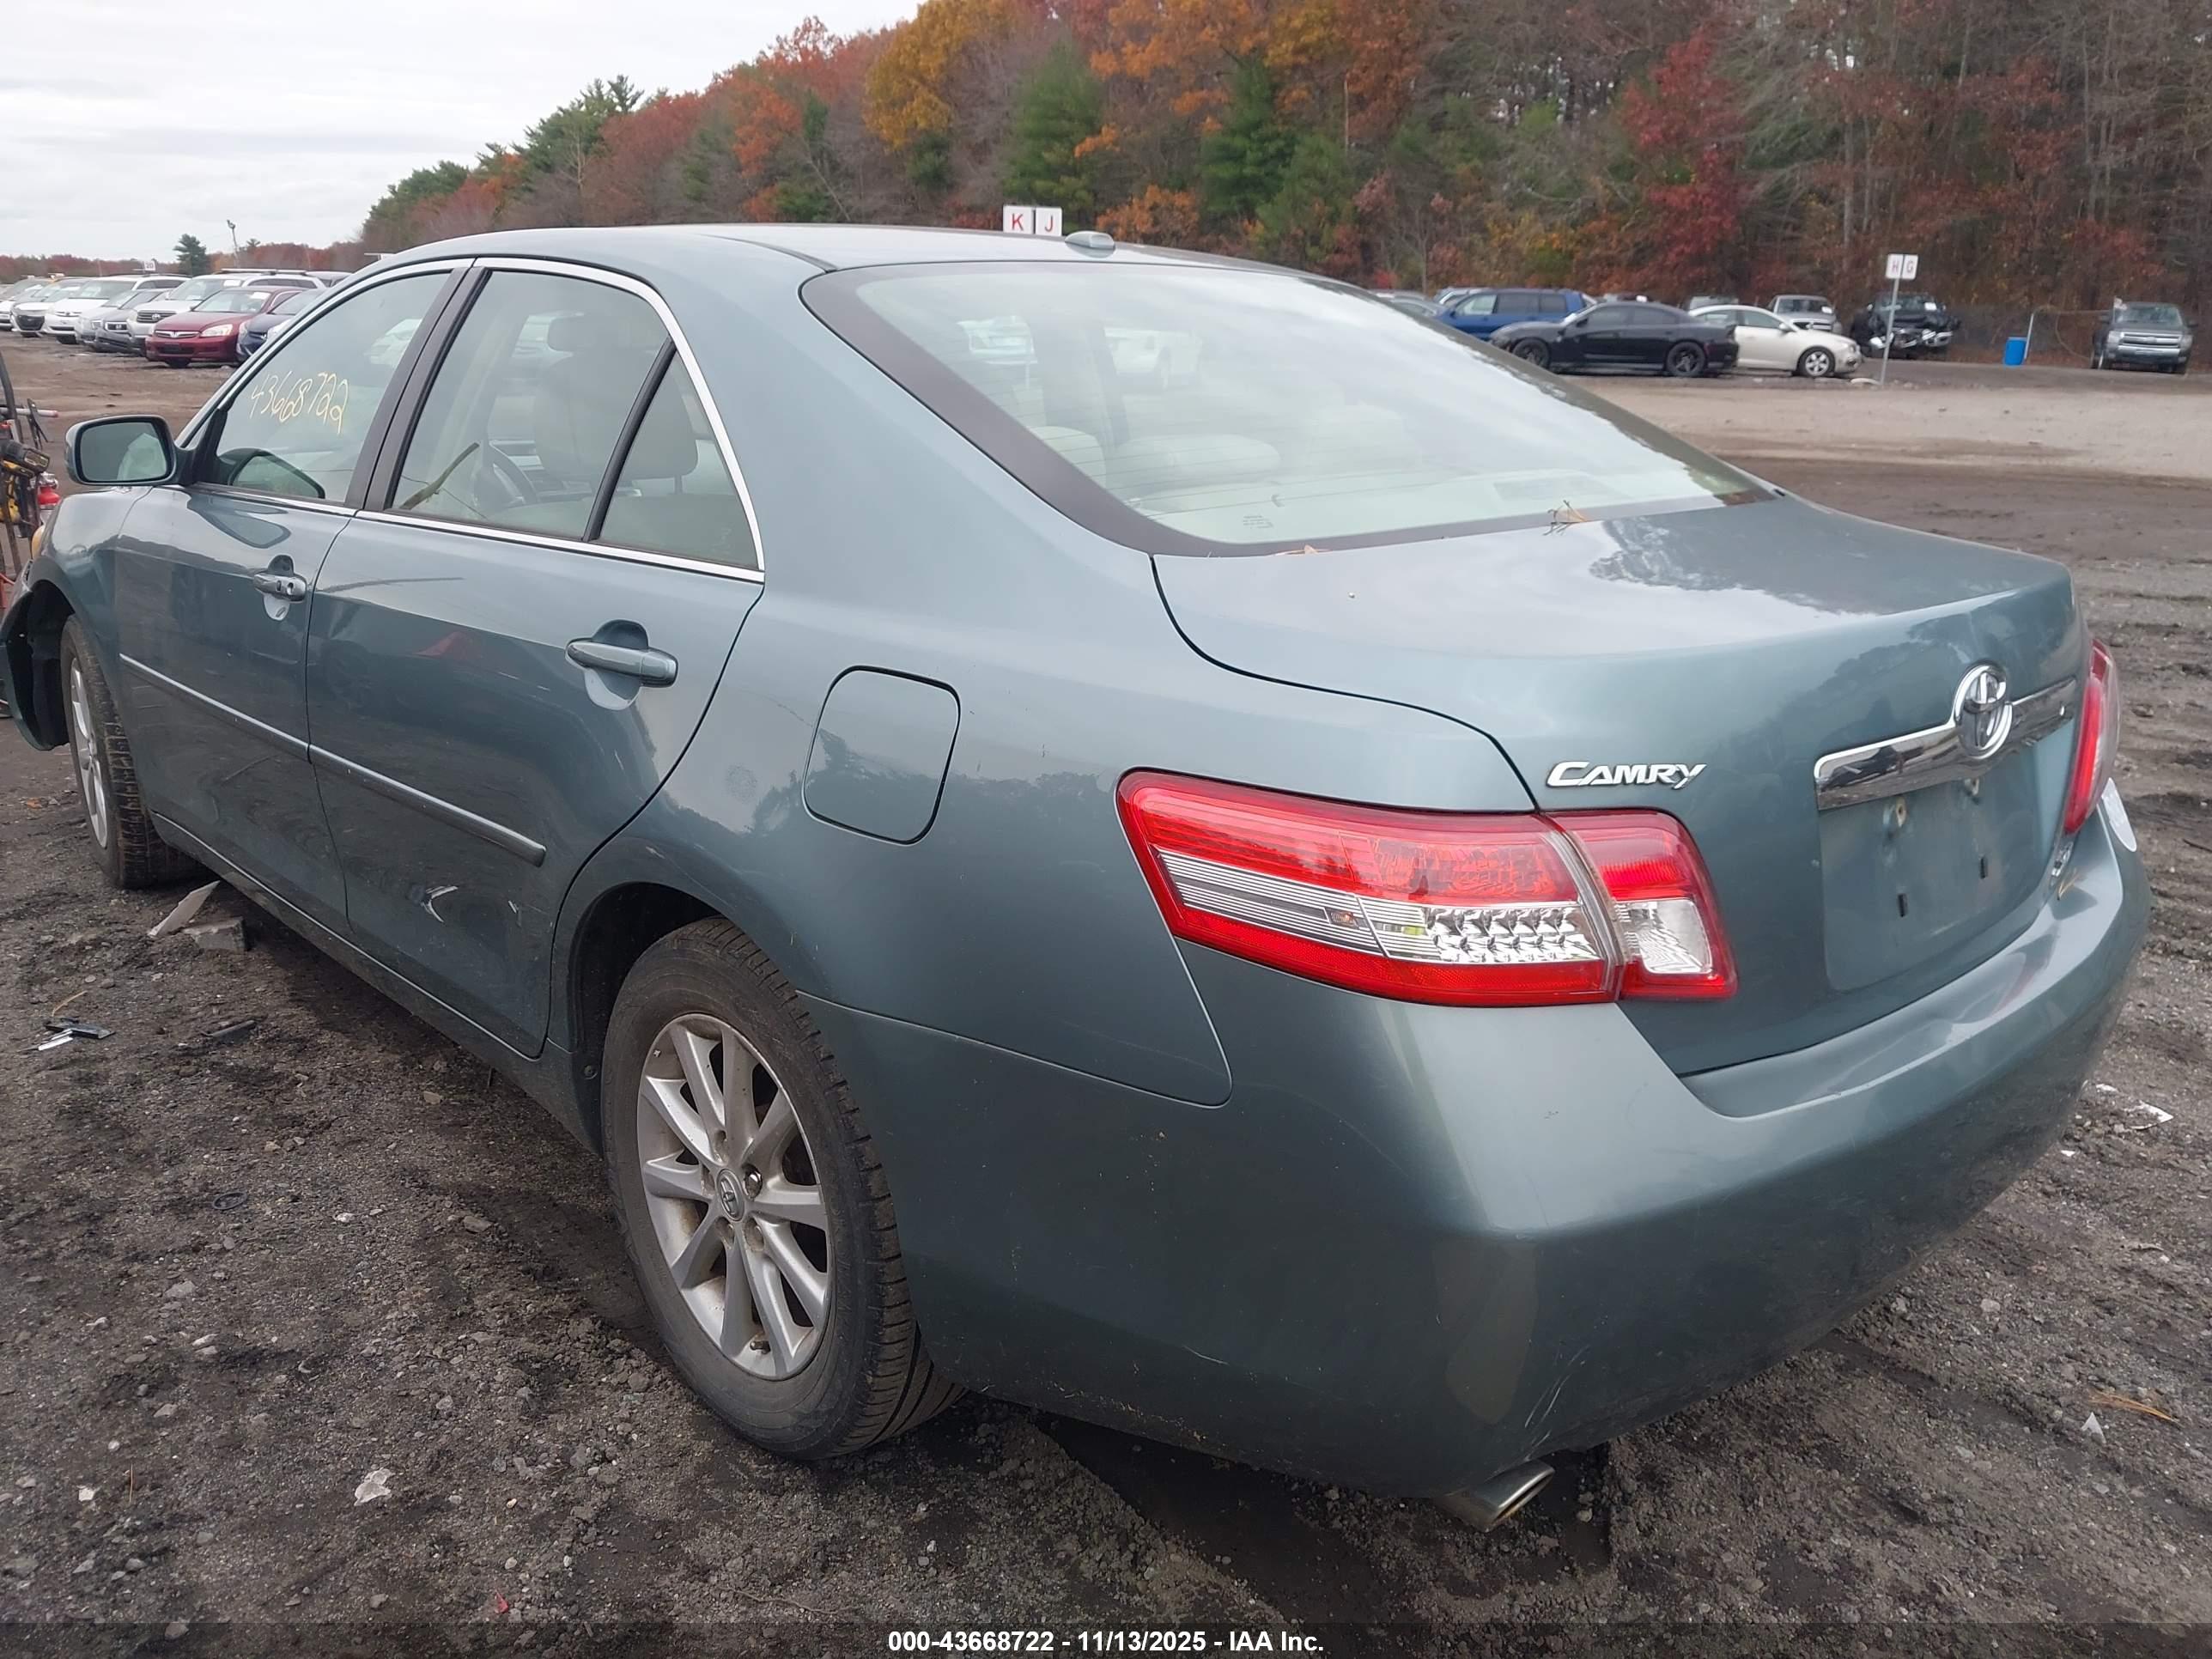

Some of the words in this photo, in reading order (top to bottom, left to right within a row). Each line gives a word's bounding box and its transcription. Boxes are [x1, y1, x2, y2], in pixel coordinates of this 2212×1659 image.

[1012, 213, 1024, 231] K
[1044, 215, 1054, 233] J
[250, 370, 349, 434] 43668722
